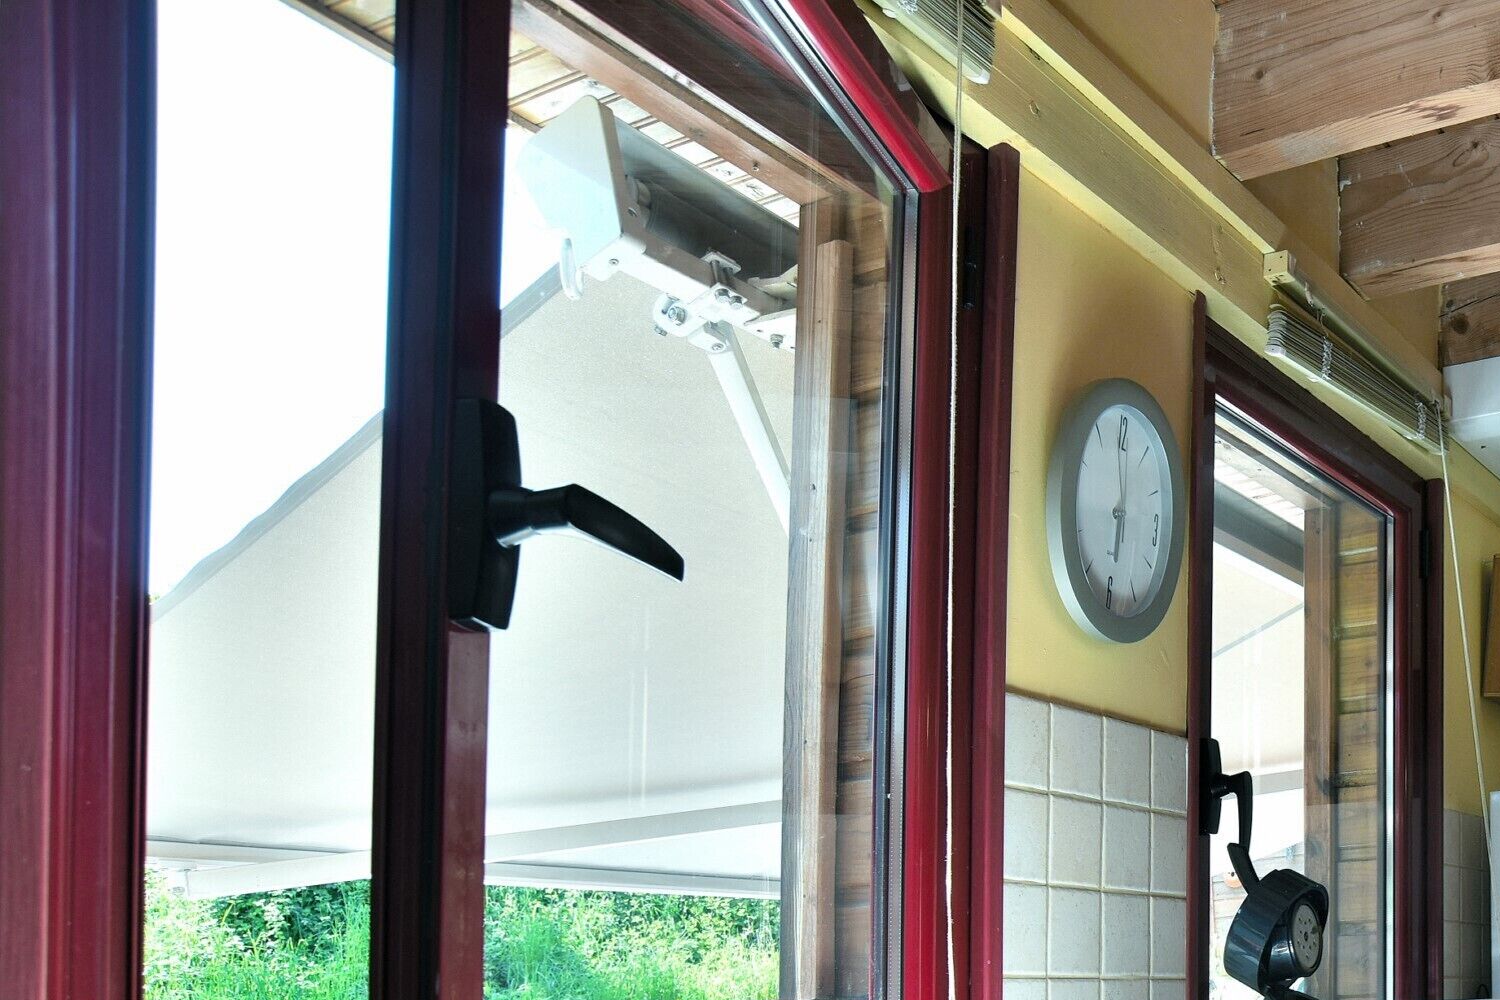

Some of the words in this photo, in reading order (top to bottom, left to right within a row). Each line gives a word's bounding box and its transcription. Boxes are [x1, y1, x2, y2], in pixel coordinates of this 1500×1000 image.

[1118, 414, 1128, 452] 12
[1152, 513, 1159, 547] 3
[1105, 575, 1114, 610] 6
